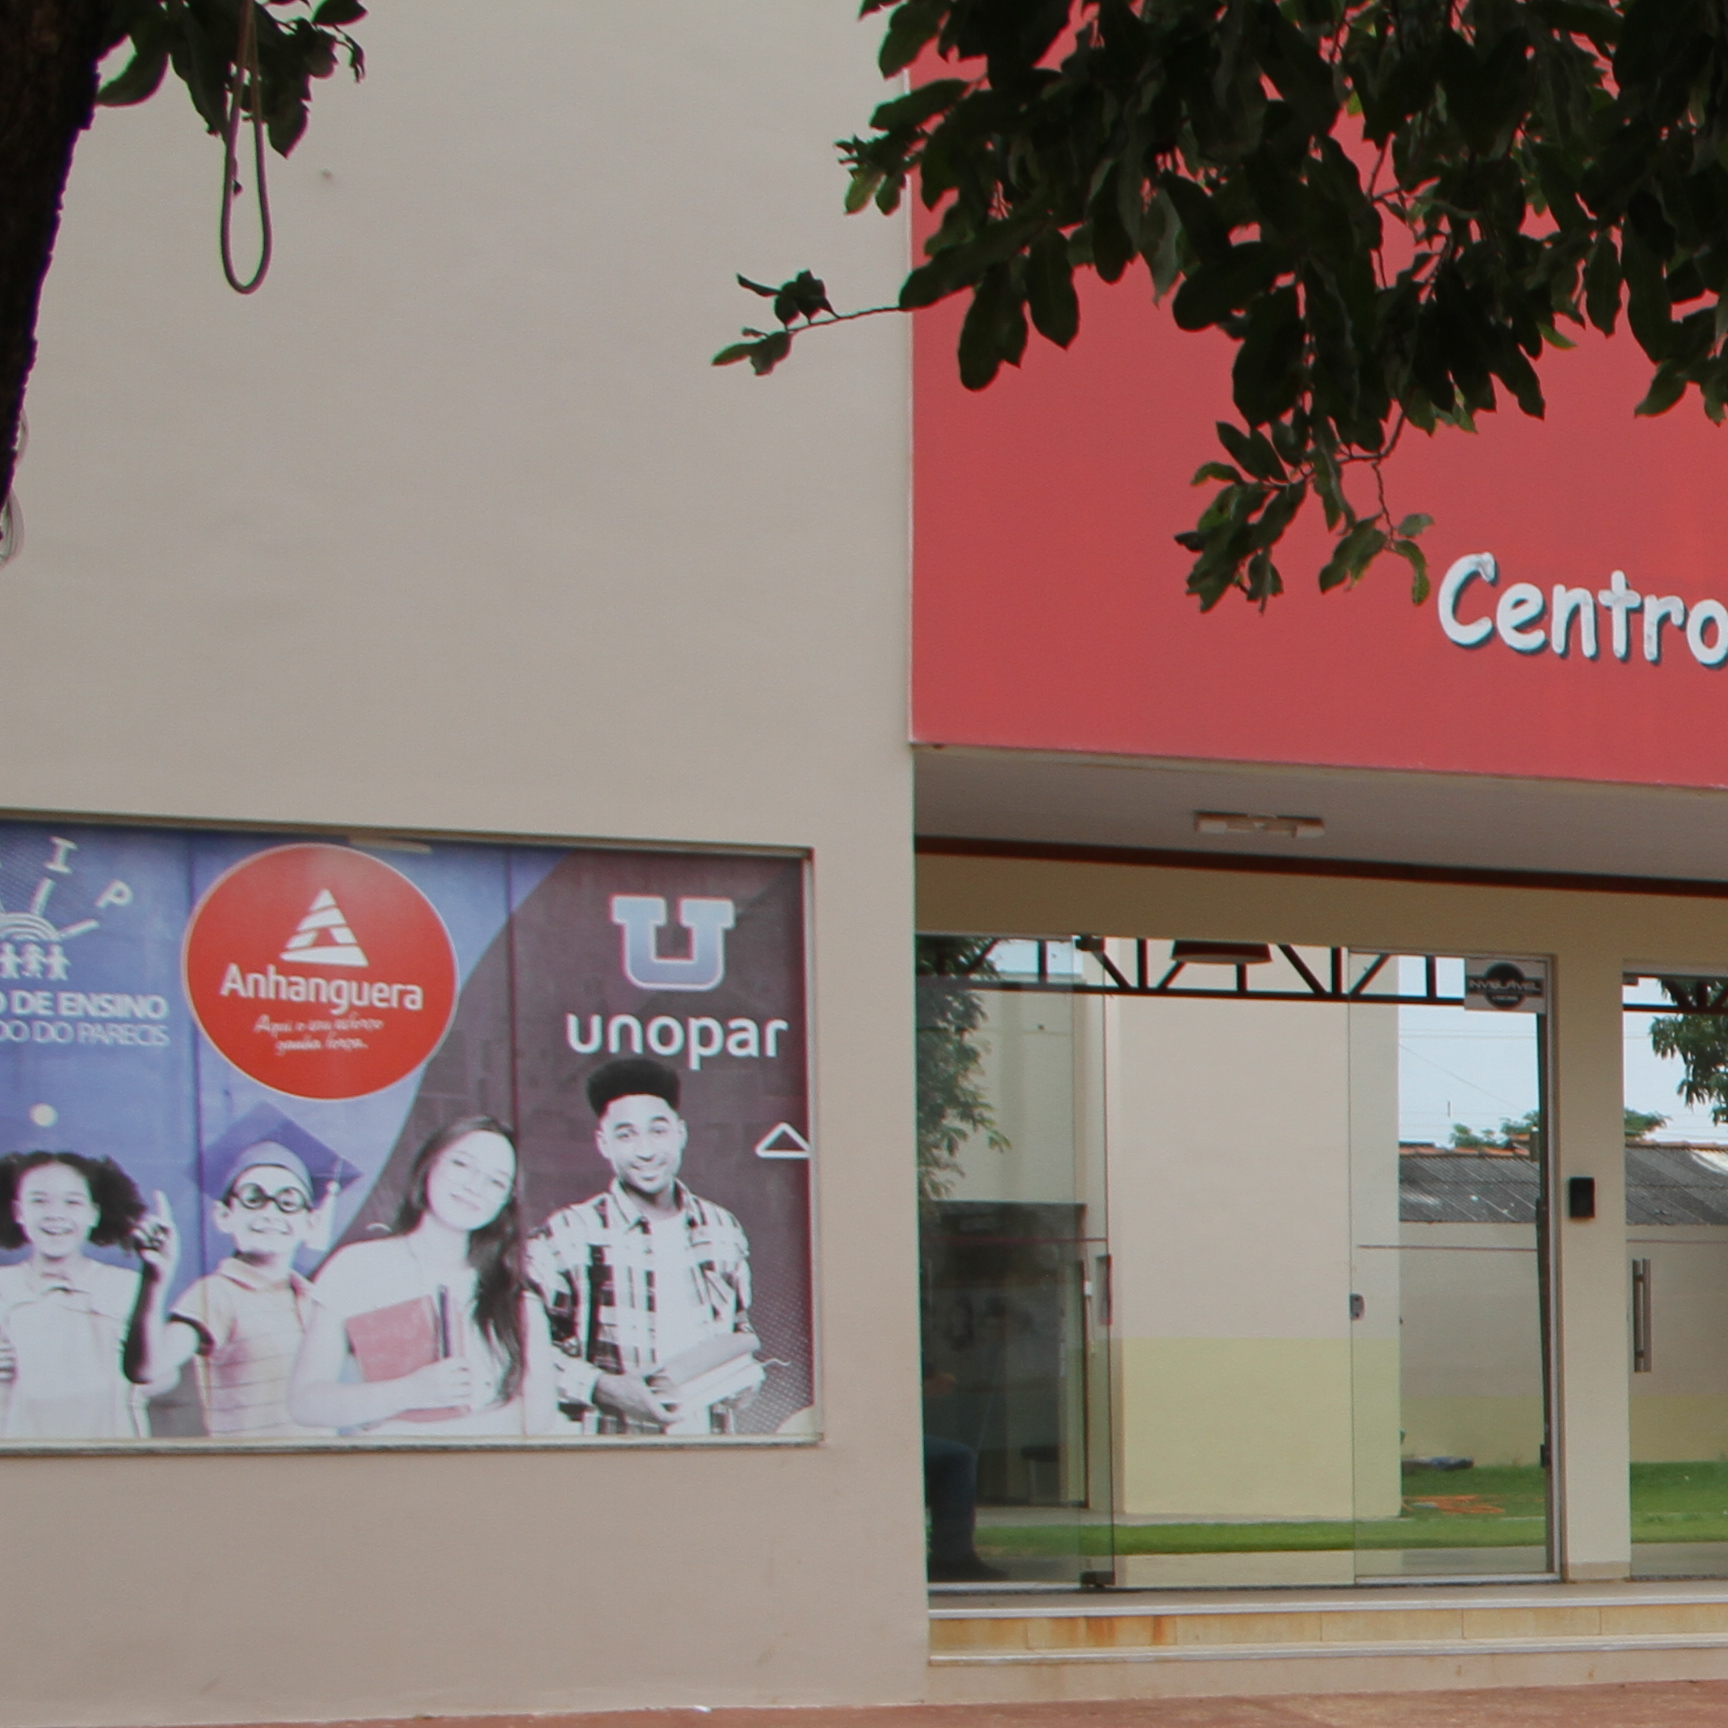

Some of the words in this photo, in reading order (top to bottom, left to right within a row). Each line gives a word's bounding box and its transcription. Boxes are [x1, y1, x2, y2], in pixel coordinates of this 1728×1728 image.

[9, 989, 54, 1016] DE
[57, 990, 170, 1020] ENSINO
[219, 962, 424, 1016] Anhanguera
[32, 1019, 75, 1044] DO
[77, 1020, 171, 1047] PARECIS
[565, 1012, 789, 1071] unopar
